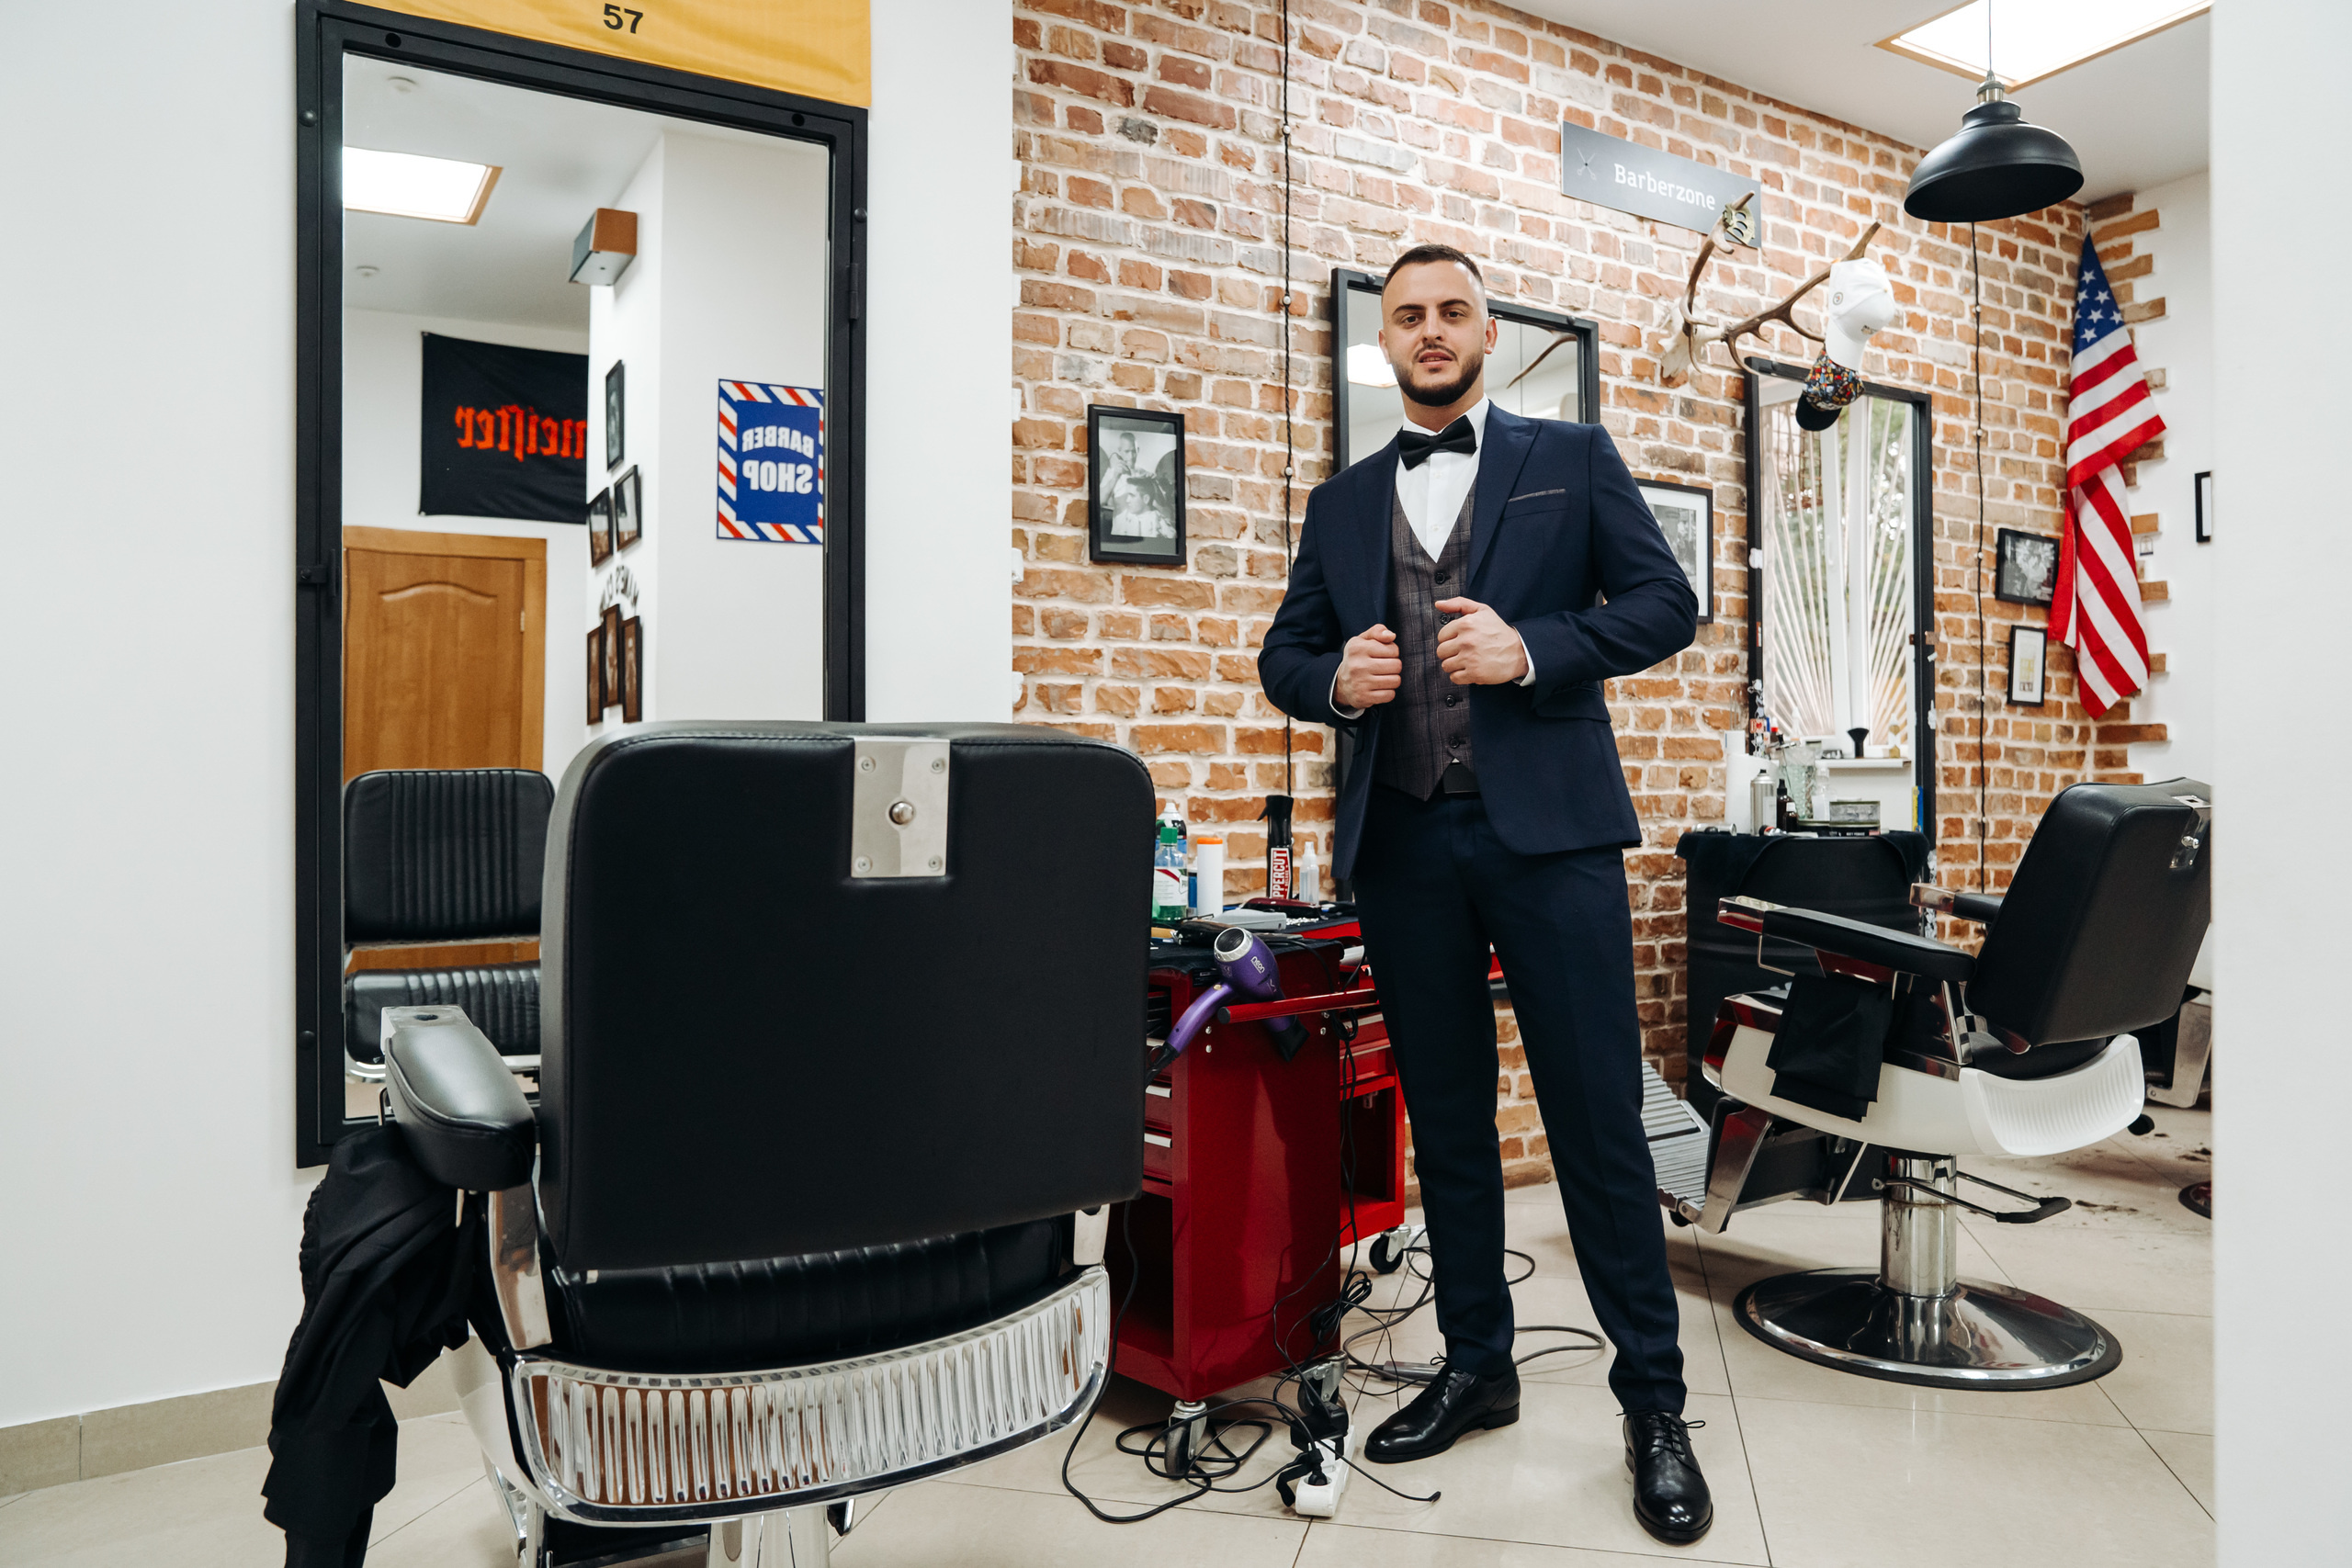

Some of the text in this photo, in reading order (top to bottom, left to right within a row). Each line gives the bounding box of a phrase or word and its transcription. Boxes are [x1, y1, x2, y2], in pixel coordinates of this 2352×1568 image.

[604, 3, 643, 34] 57
[1614, 163, 1715, 210] Barberzone
[1272, 851, 1287, 897] PPERCUT
